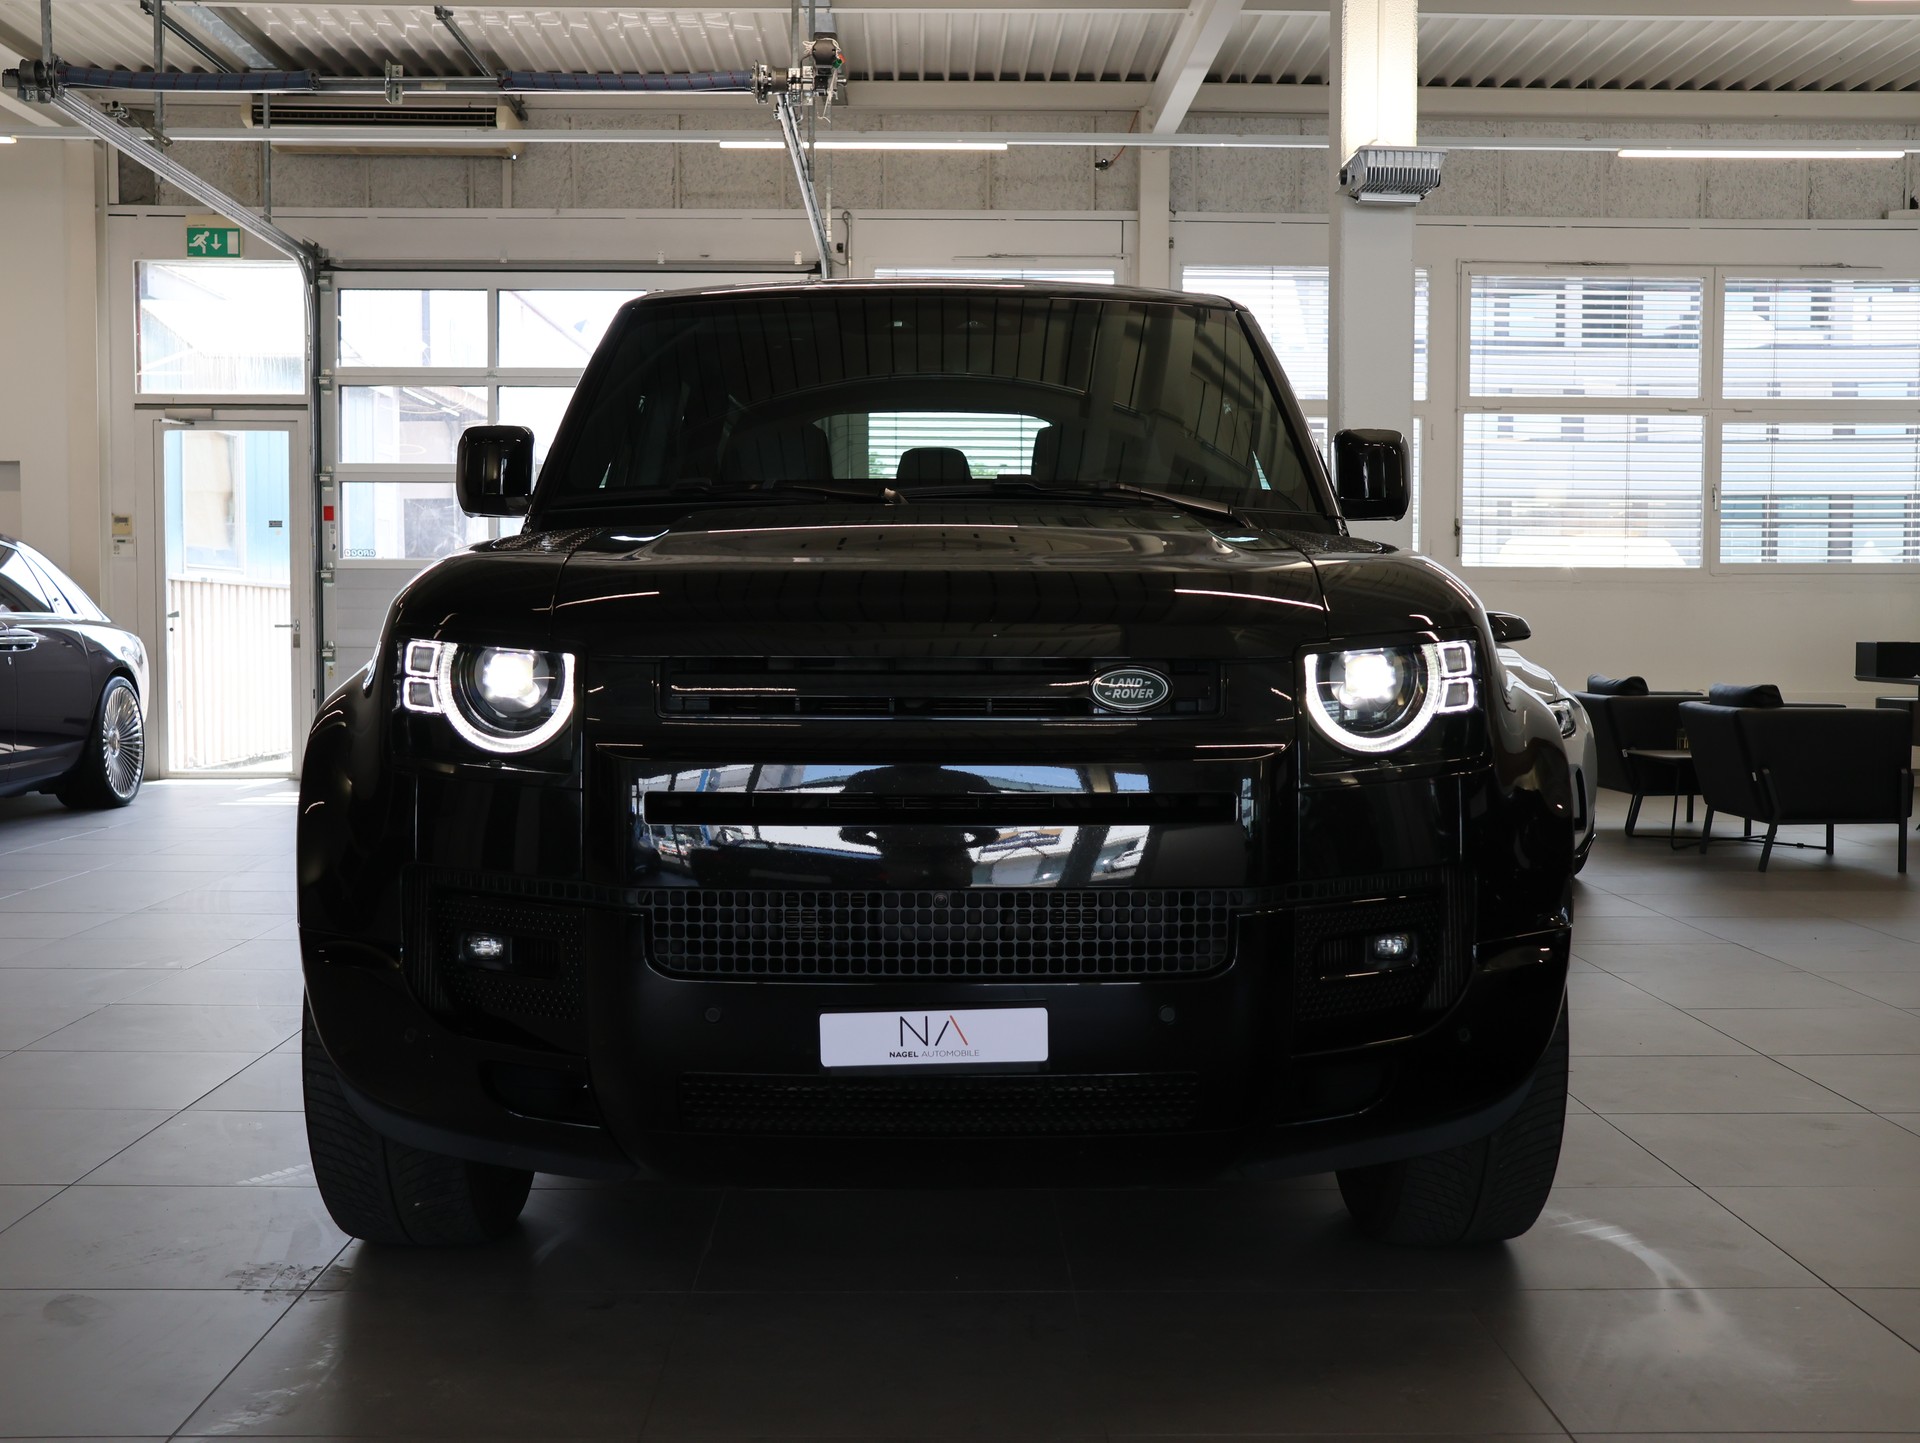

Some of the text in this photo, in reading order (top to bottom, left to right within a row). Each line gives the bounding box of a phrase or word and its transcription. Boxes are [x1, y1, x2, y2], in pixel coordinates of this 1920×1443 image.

[1109, 678, 1143, 688] LAND
[1112, 688, 1154, 699] ROVER
[921, 1050, 980, 1058] AUTOMOBILE
